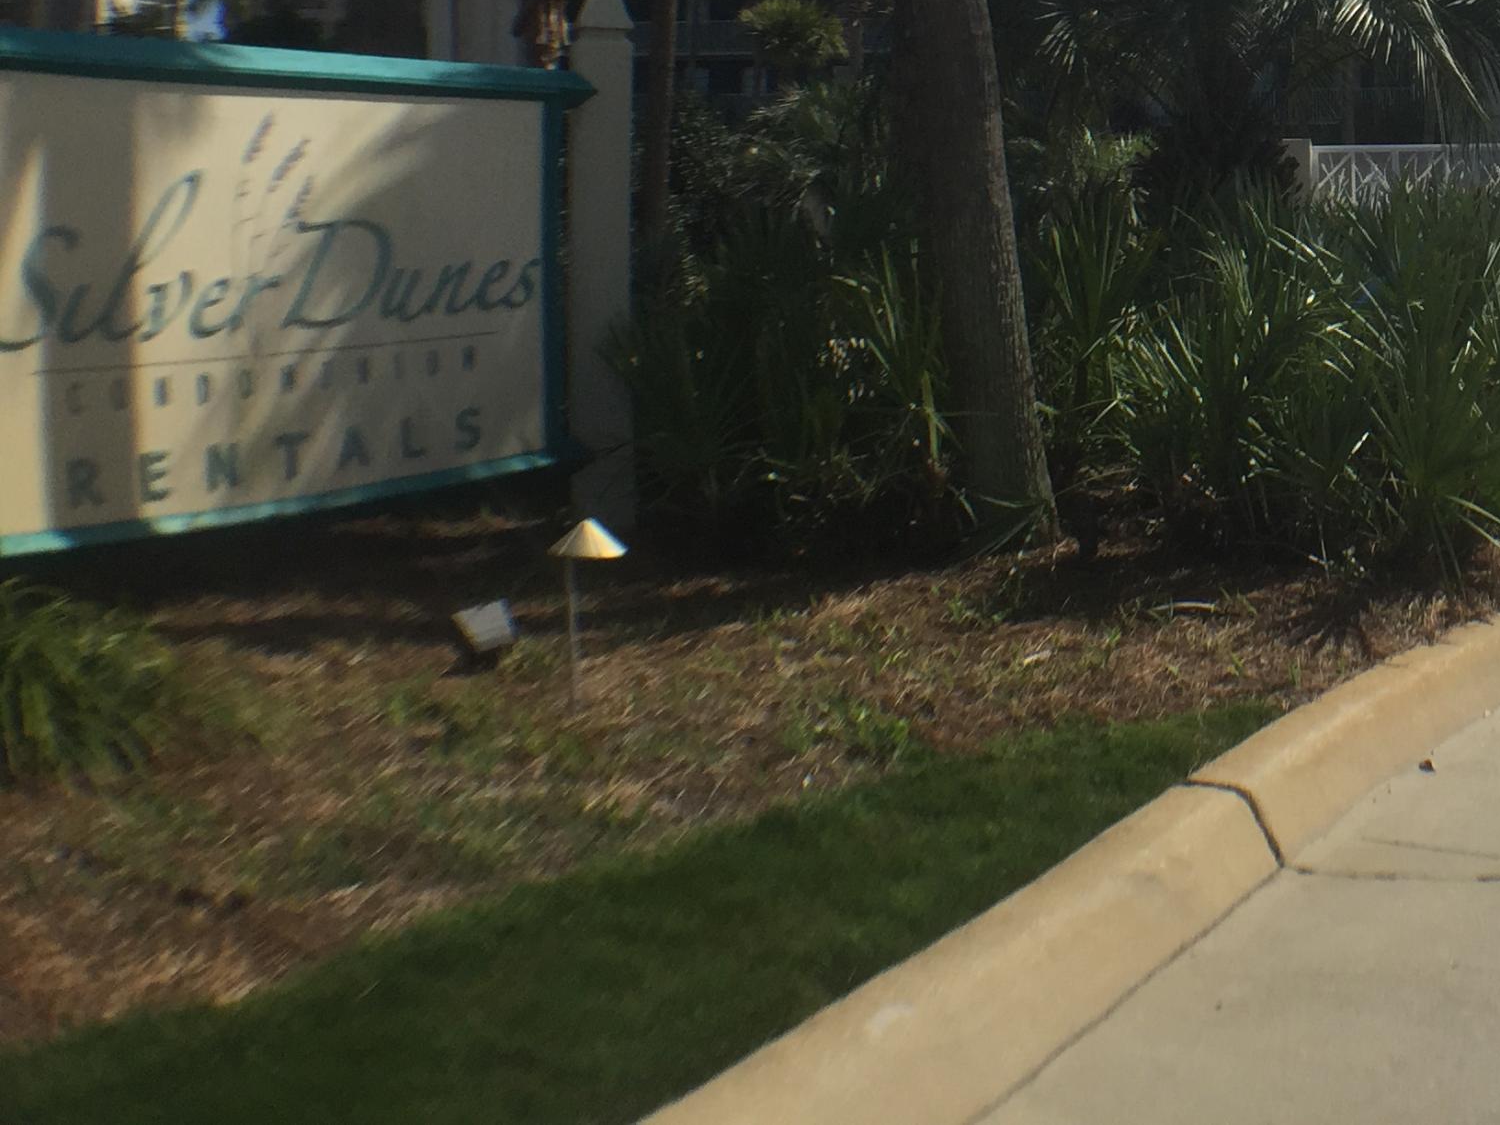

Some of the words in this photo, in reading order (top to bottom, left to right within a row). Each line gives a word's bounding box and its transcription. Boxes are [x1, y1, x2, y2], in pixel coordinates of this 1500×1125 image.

[0, 169, 281, 352] Silver
[282, 219, 542, 331] Dunes
[65, 407, 483, 508] RENTALS
